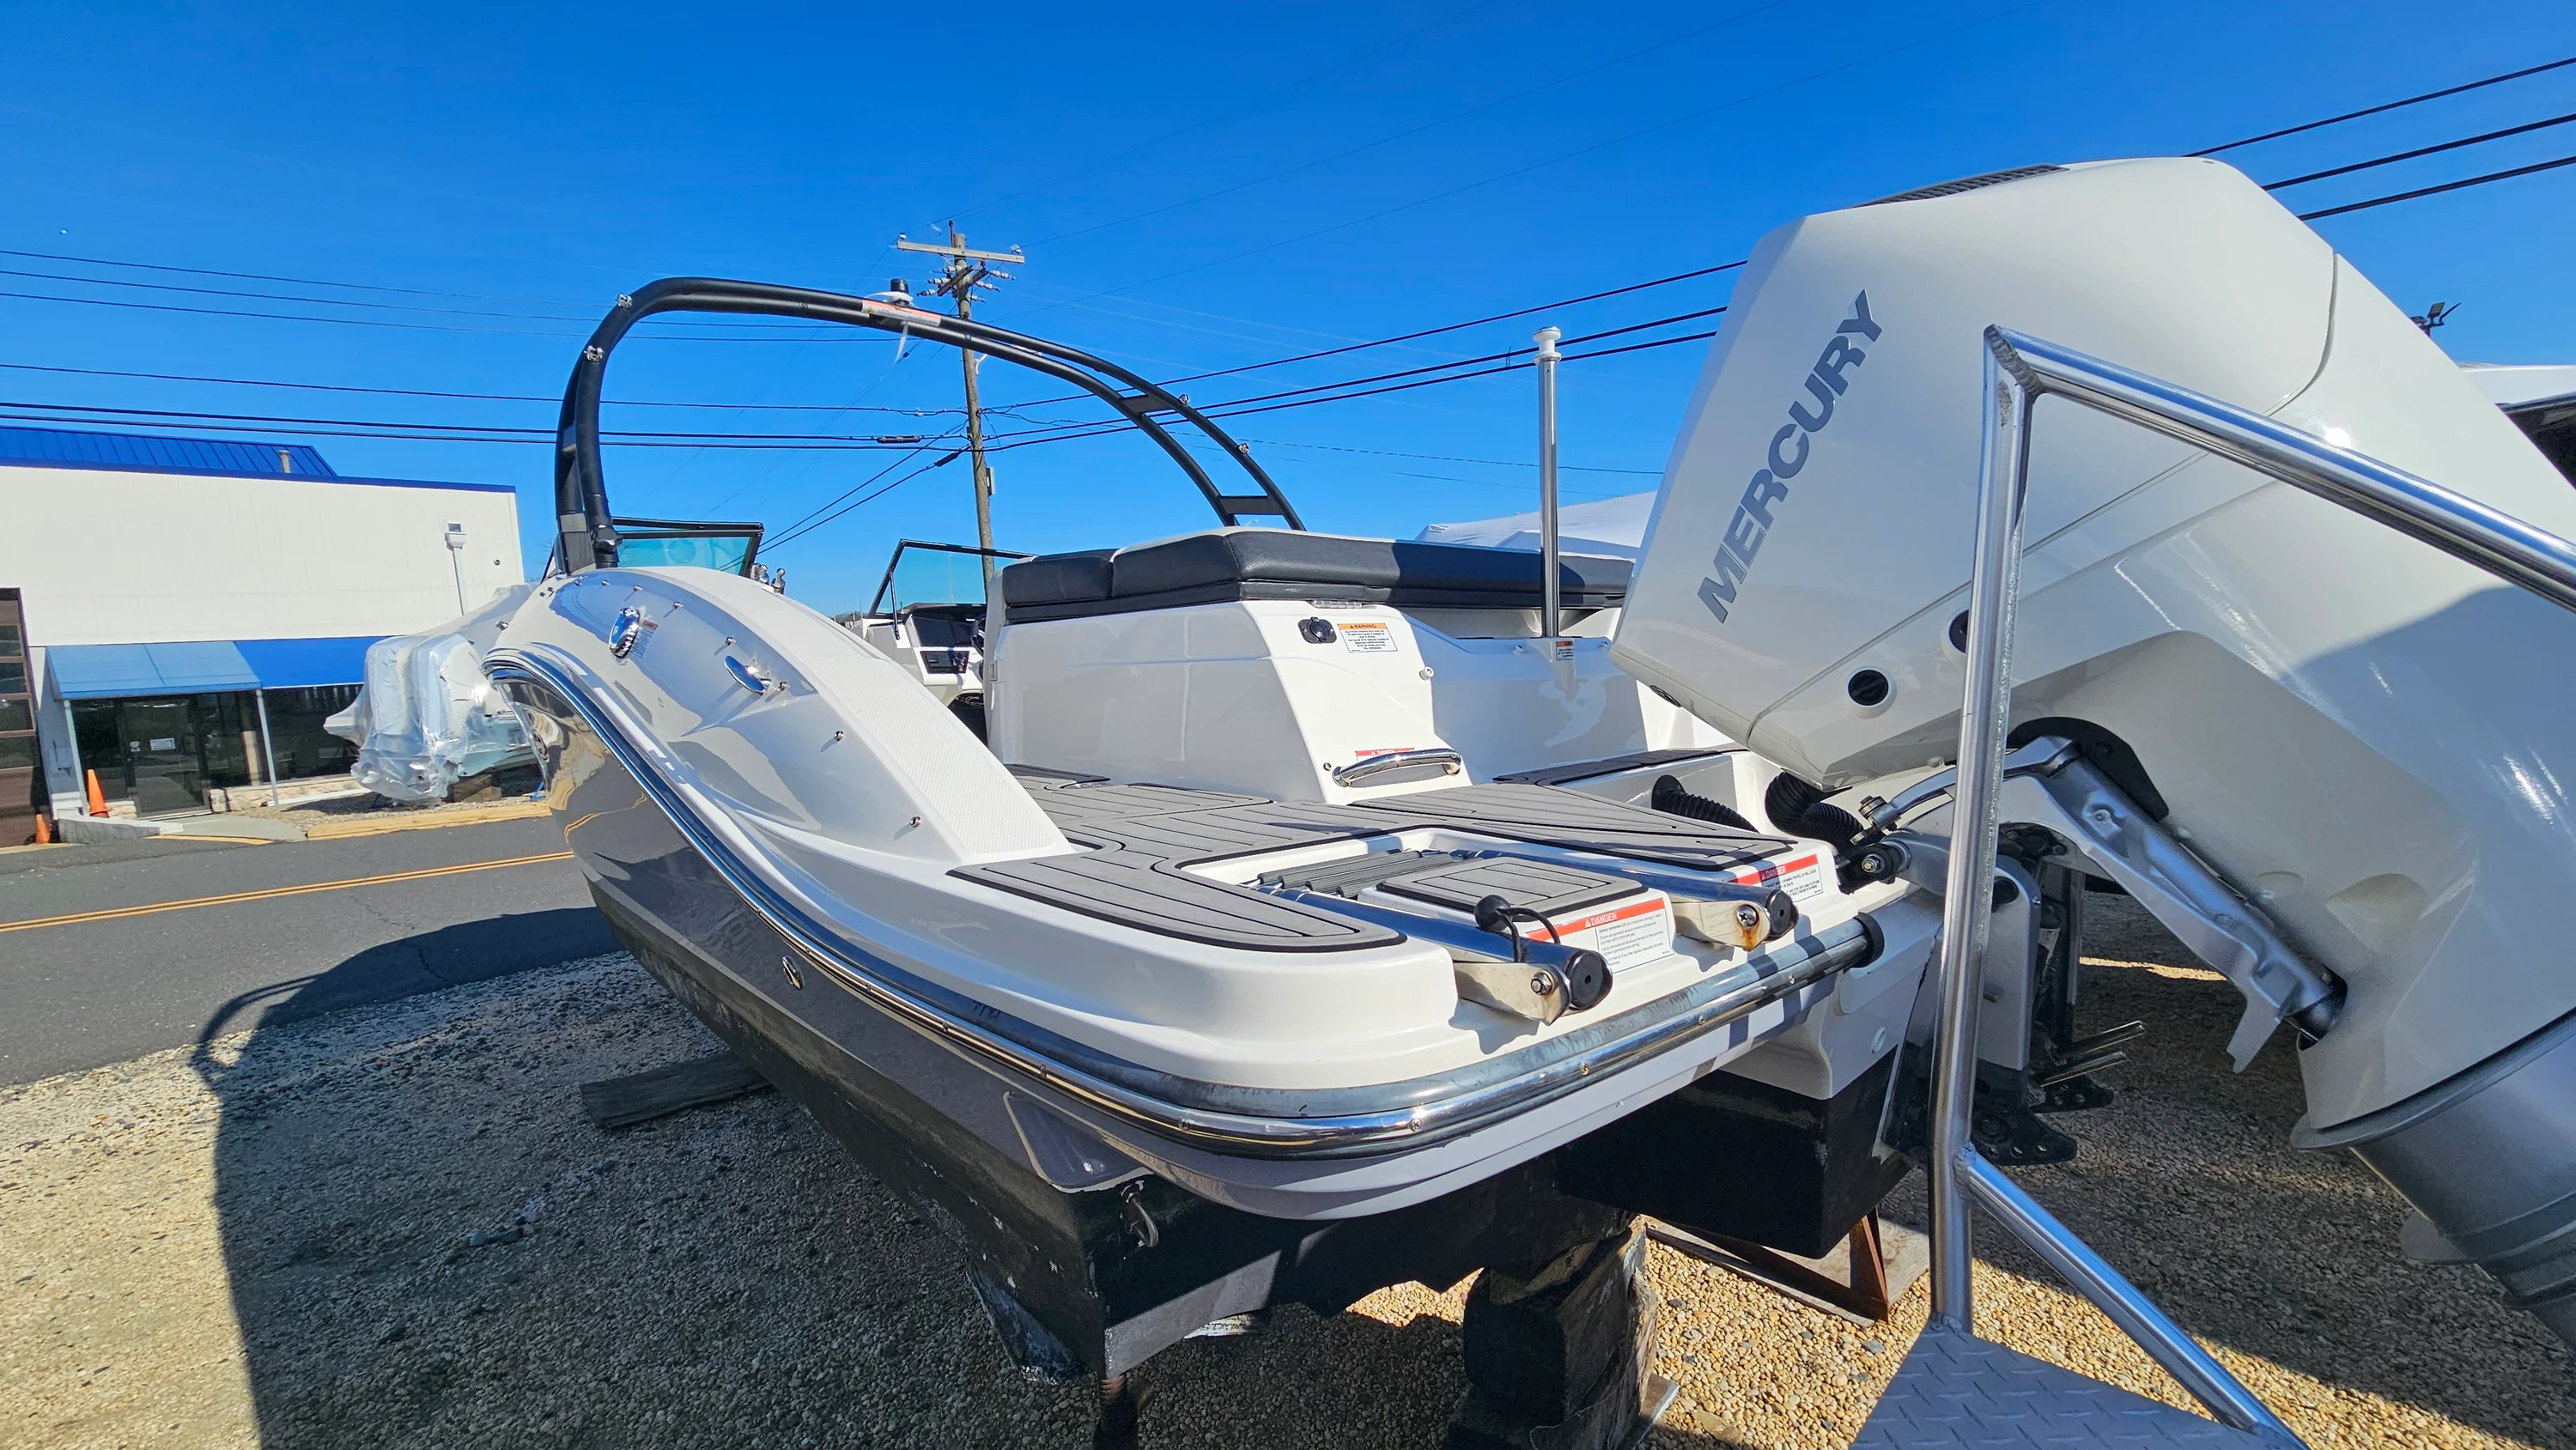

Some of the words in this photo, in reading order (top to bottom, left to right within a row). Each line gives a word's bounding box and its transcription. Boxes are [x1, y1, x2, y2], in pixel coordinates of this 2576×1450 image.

[1697, 288, 1883, 624] MERCURY
[1765, 865, 1786, 878] DANGER
[1591, 913, 1617, 926] DANGER
